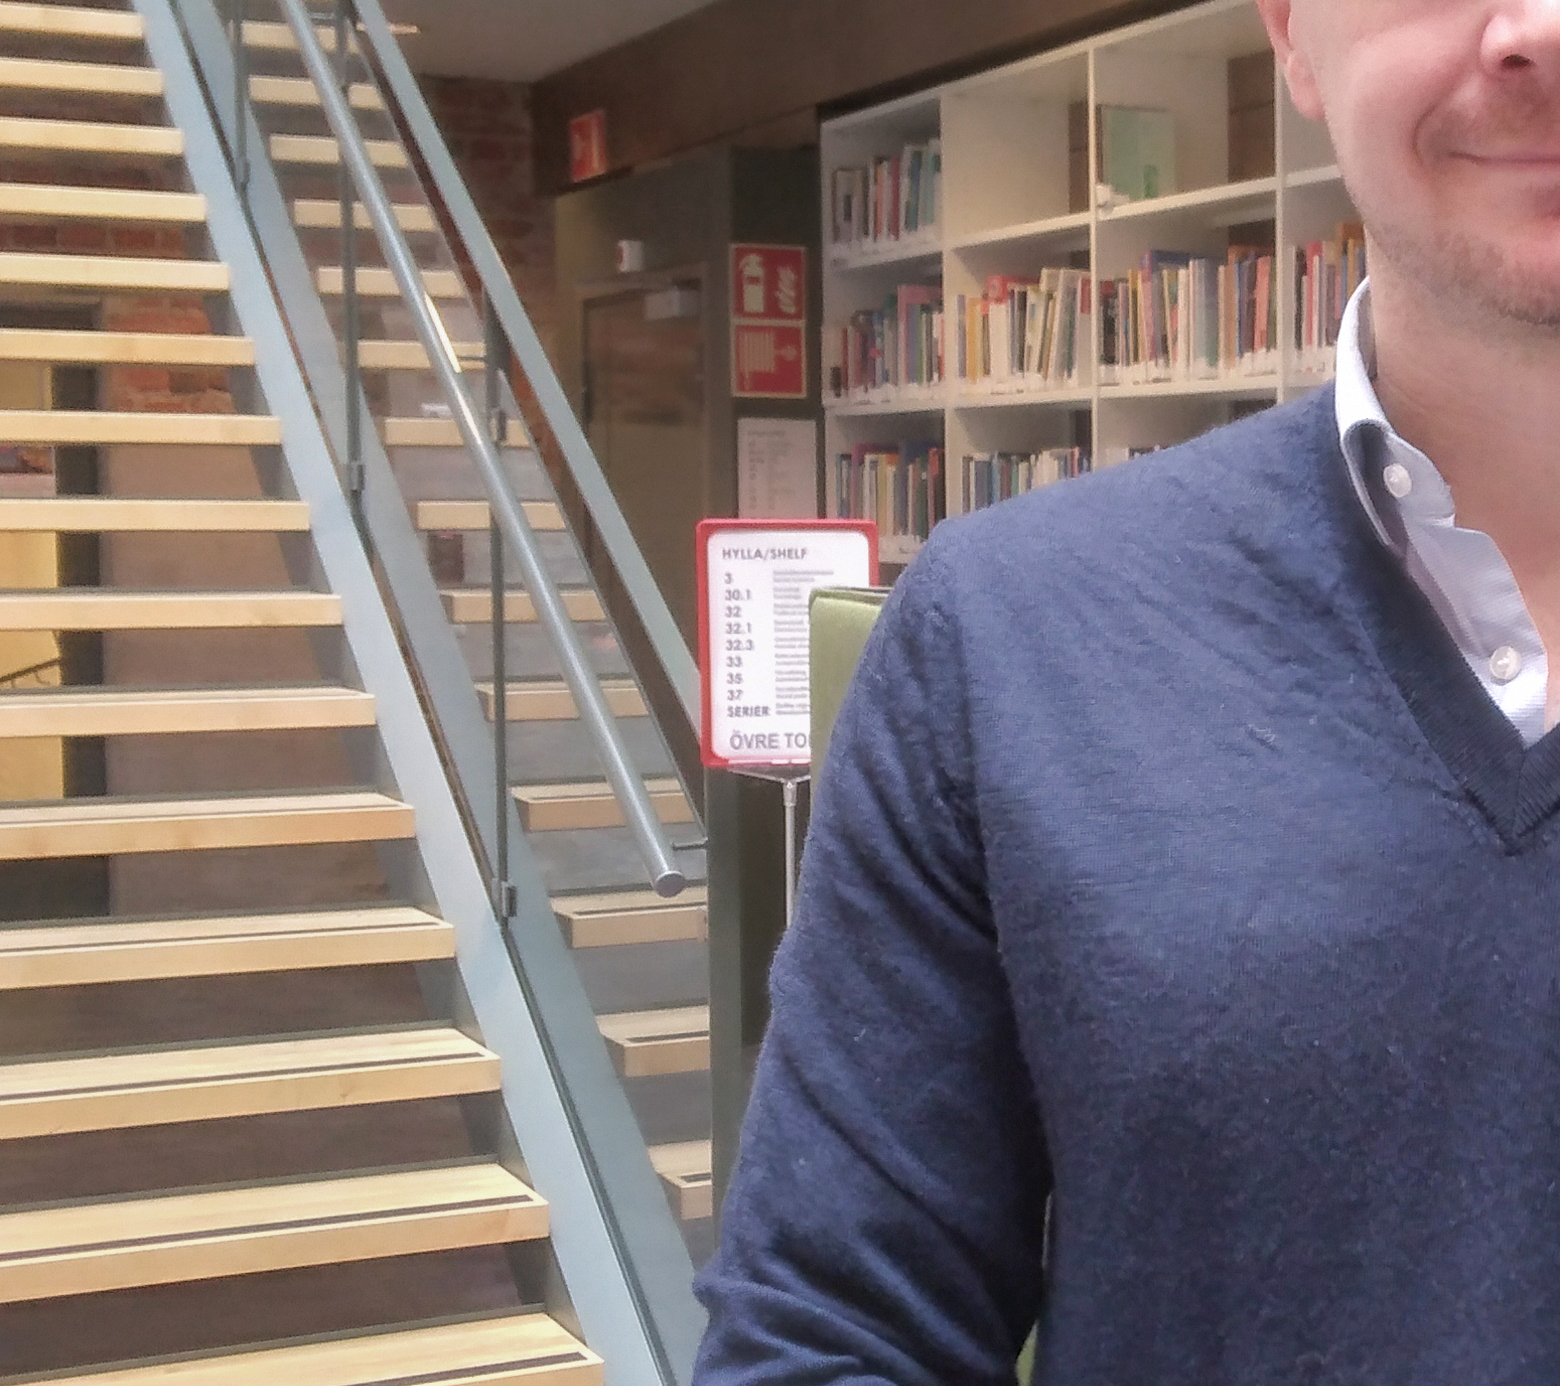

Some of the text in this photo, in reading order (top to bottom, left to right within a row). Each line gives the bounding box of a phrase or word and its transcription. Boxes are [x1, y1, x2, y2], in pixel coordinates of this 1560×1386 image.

[722, 547, 807, 561] HYLLA/SHELF
[724, 572, 732, 584] 3
[725, 589, 750, 601] 30.1
[725, 605, 741, 618] 32
[725, 621, 751, 634] 32.1
[726, 639, 754, 651] 32.3
[726, 656, 743, 668] 33
[727, 689, 744, 701] 37
[727, 706, 769, 717] SERIER
[729, 728, 810, 750] ÖVRE TO
